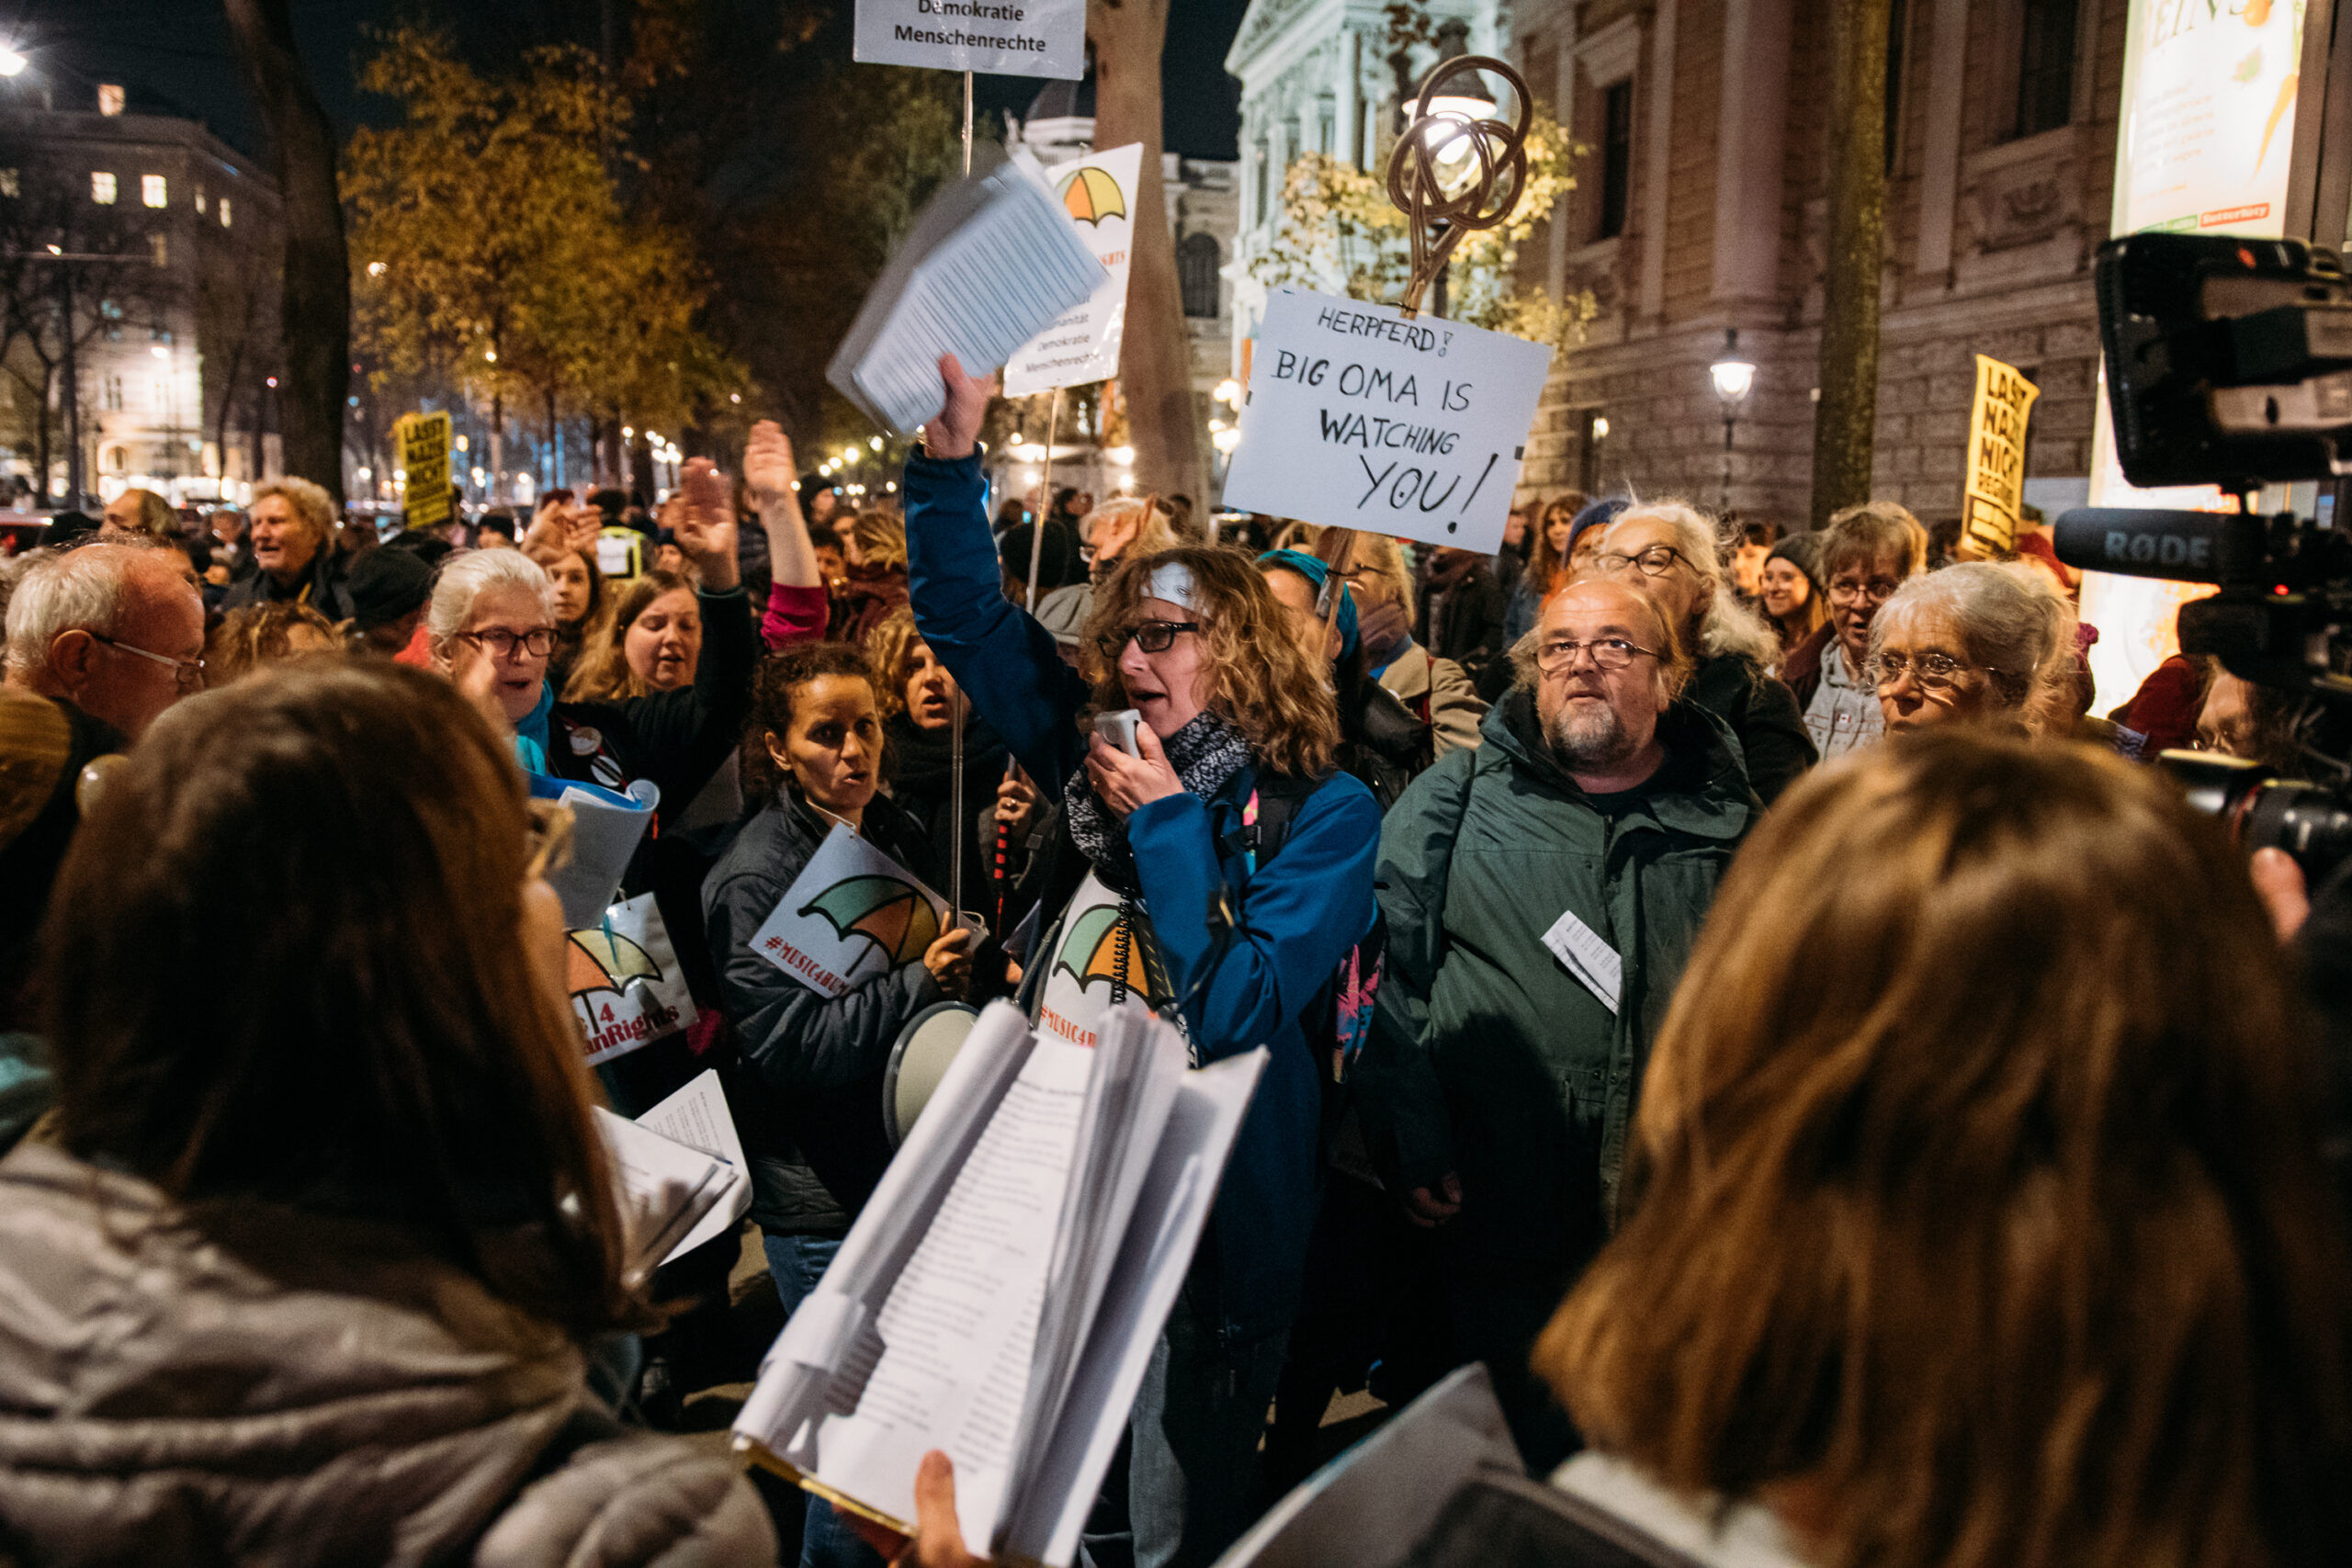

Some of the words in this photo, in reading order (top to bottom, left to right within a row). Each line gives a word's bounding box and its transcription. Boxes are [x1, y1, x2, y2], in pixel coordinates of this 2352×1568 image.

[919, 0, 1024, 21] Demokratie
[895, 24, 1046, 51] Menschenrechte
[1317, 306, 1453, 357] HERPFERD!
[1271, 349, 1329, 387] BIG
[1340, 364, 1419, 406] OMA
[1442, 380, 1473, 412] IS
[1320, 408, 1461, 456] WATCHING
[1357, 453, 1499, 534] YOU!
[764, 936, 851, 996] #MUSIC4HUM
[584, 1006, 680, 1055] anRights
[600, 1002, 615, 1022] 4
